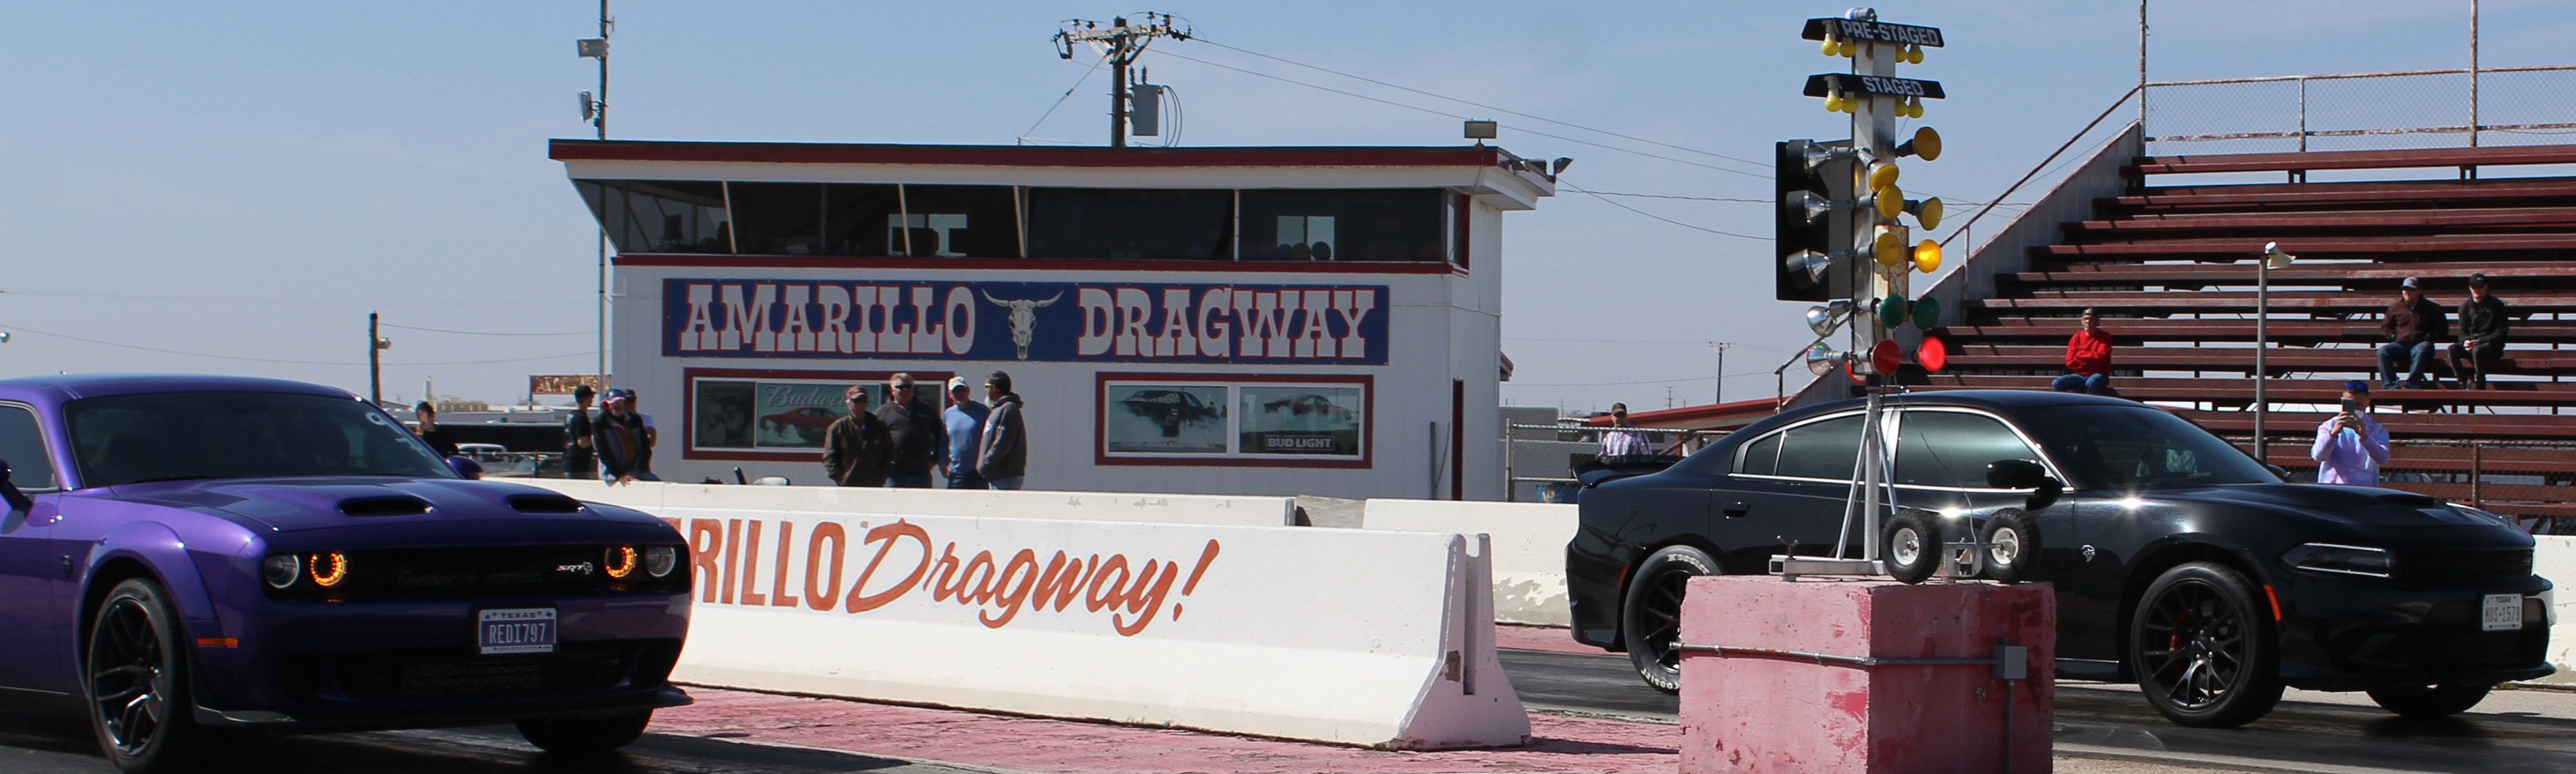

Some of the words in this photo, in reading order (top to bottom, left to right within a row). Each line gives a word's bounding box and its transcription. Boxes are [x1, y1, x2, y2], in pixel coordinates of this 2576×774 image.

[1840, 20, 1939, 46] PRE-STAGED
[1862, 76, 1925, 96] STAGED
[679, 281, 977, 356] AMARILLO
[1077, 286, 1376, 359] DRAGWAY
[1268, 437, 1294, 447] BUD
[1295, 438, 1332, 448] LIGHT
[845, 517, 1221, 637] Dragway!
[489, 623, 546, 644] REDI797
